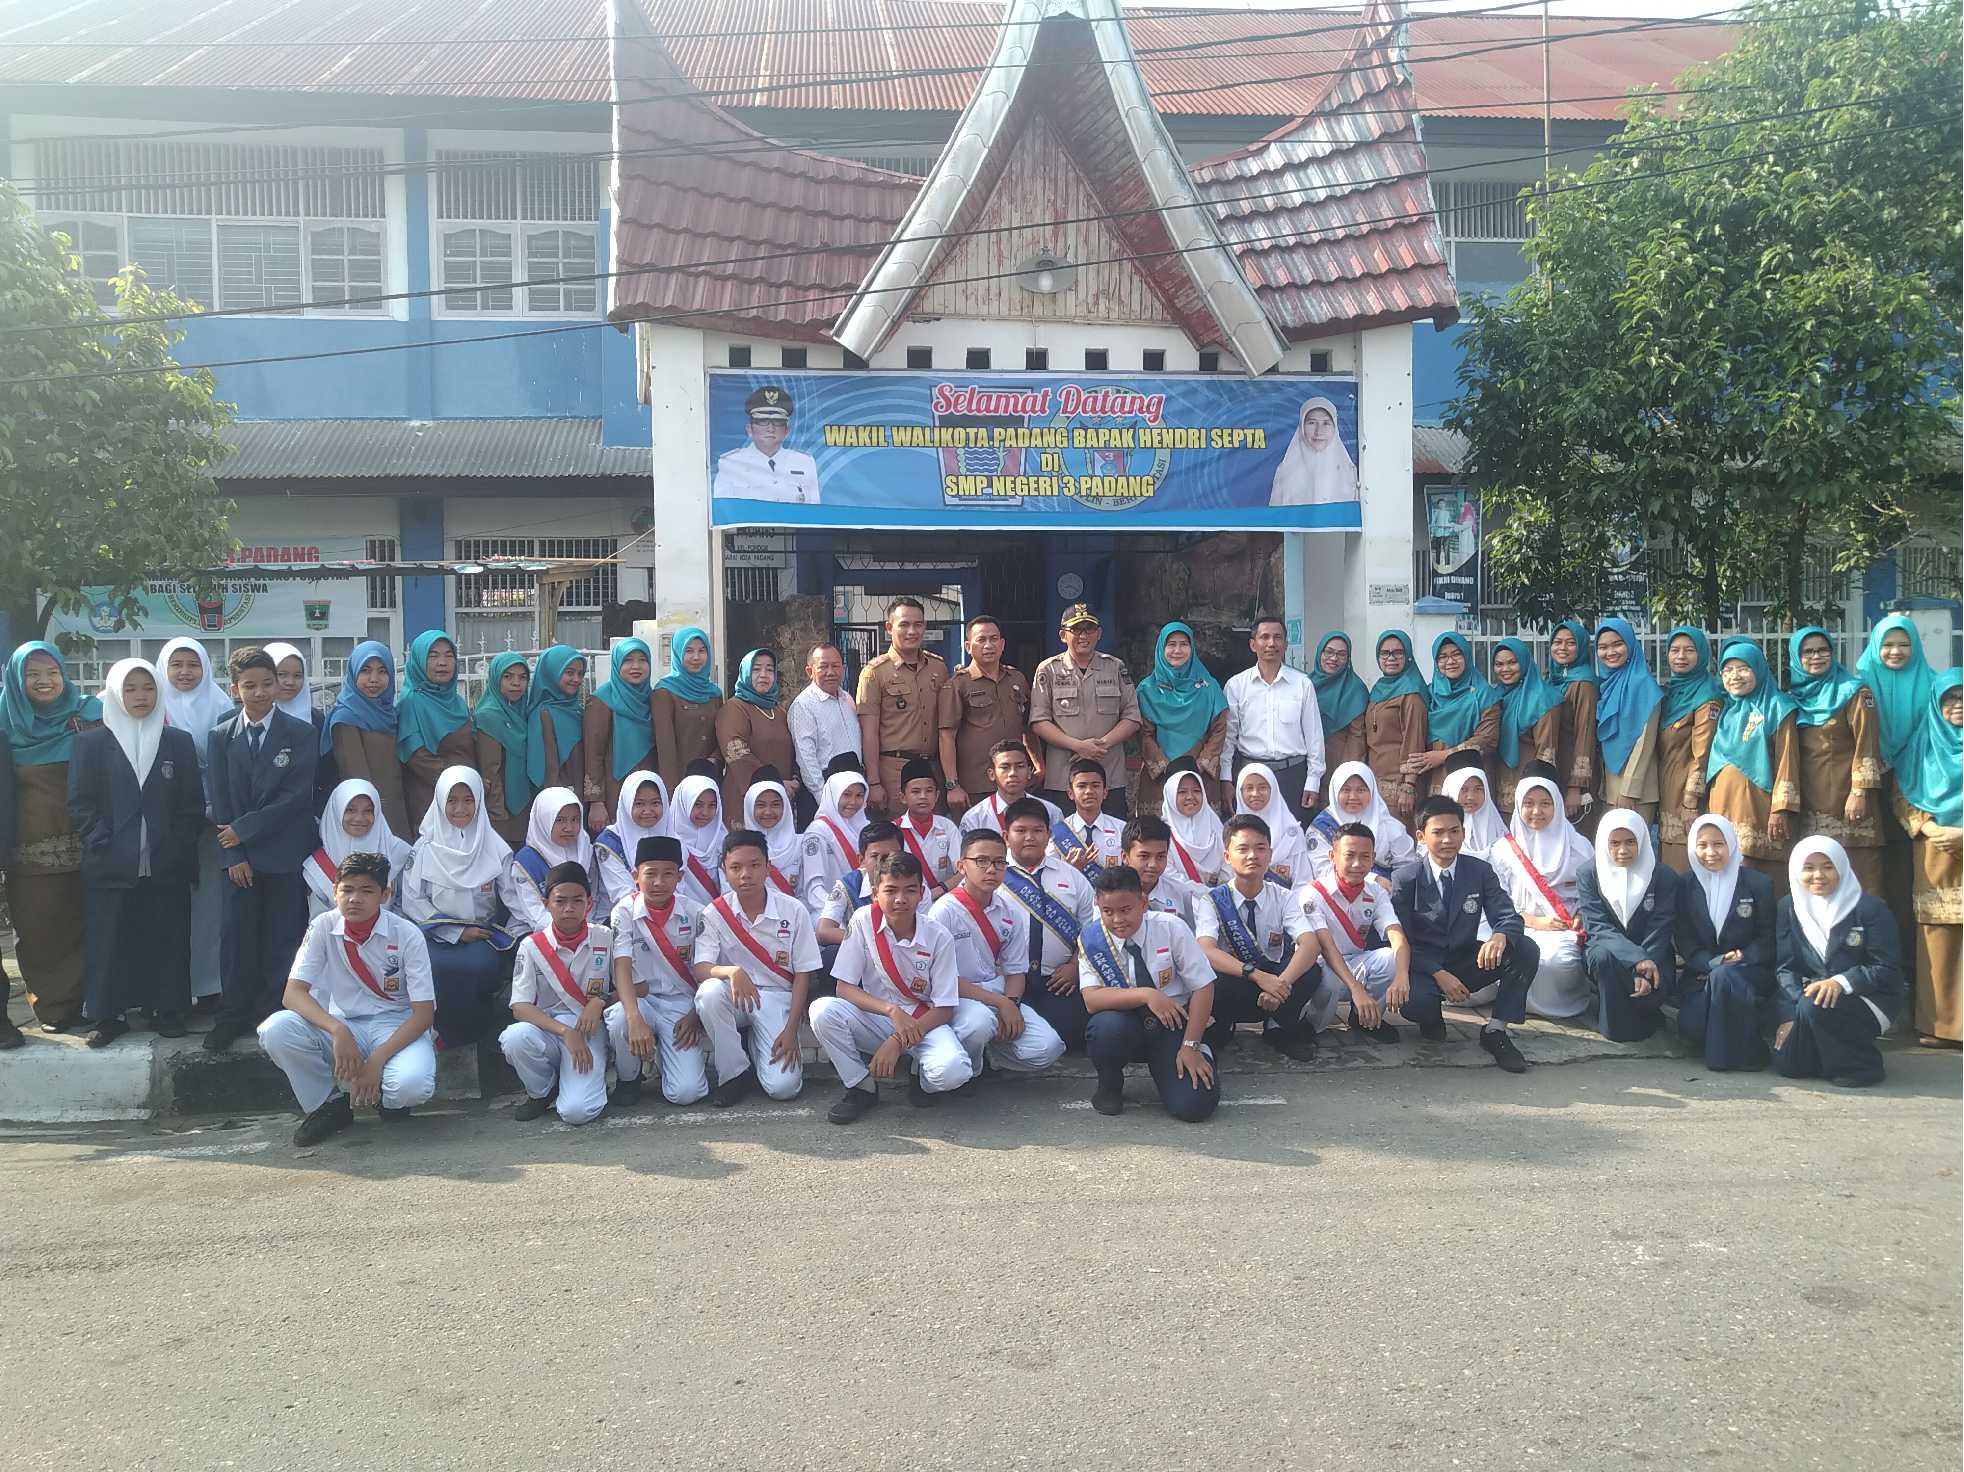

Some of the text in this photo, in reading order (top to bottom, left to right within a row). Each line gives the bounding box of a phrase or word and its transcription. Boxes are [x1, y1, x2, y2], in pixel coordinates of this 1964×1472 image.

[933, 382, 1167, 426] Selamat Datang
[824, 425, 1267, 449] WAKIL WALIKOTA PADANG BAPAK HENDRI SEPTA
[1040, 453, 1061, 472] DI
[945, 474, 1156, 497] SMP NEGERI 3 PADANG
[240, 546, 320, 563] PADANG
[150, 583, 177, 594] BAGI
[232, 583, 269, 594] SISWA
